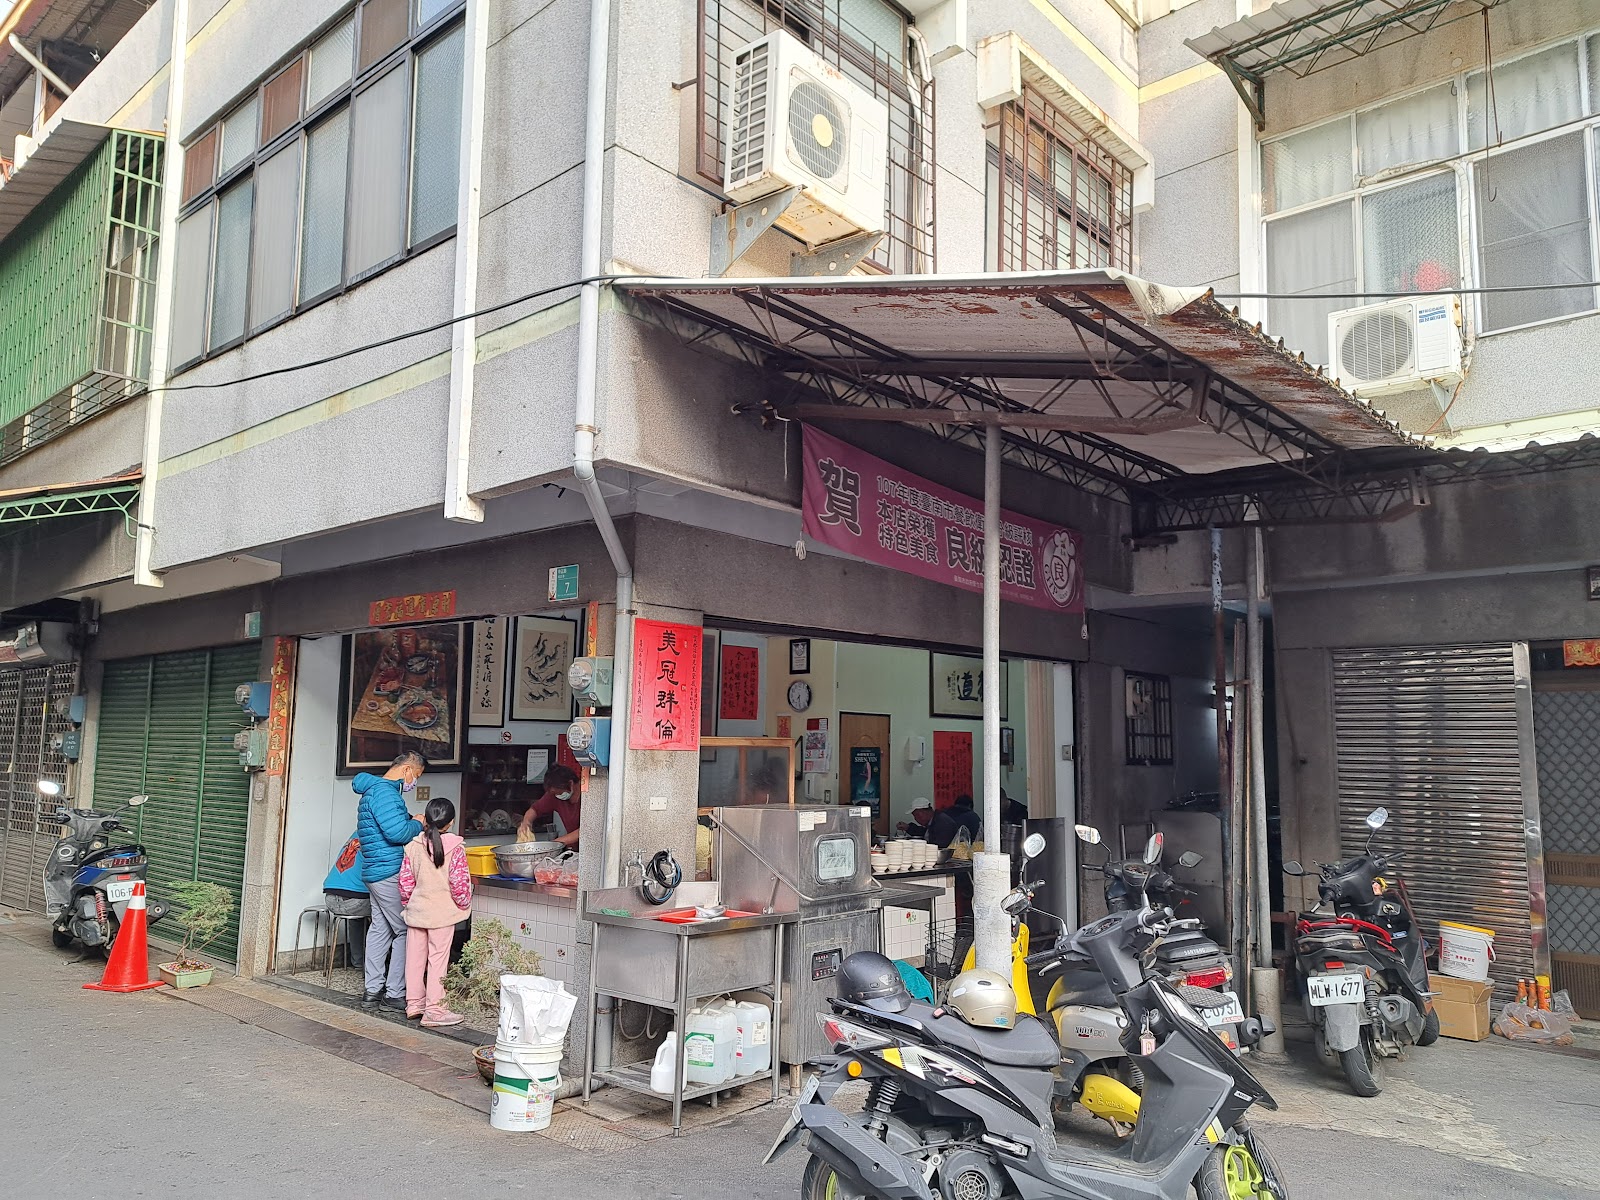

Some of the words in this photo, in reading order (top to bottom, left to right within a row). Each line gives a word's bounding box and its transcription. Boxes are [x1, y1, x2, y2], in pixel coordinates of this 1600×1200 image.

[818, 457, 862, 537] 賀
[877, 475, 1033, 547] 107年度臺南市餐飲衛級評核
[877, 498, 936, 541] 本店榮獲
[878, 523, 939, 566] 特色美食
[564, 582, 570, 594] 7
[1055, 561, 1066, 582] 良
[654, 629, 681, 741] 美冠群倫
[1310, 981, 1360, 999] MLW-1677
